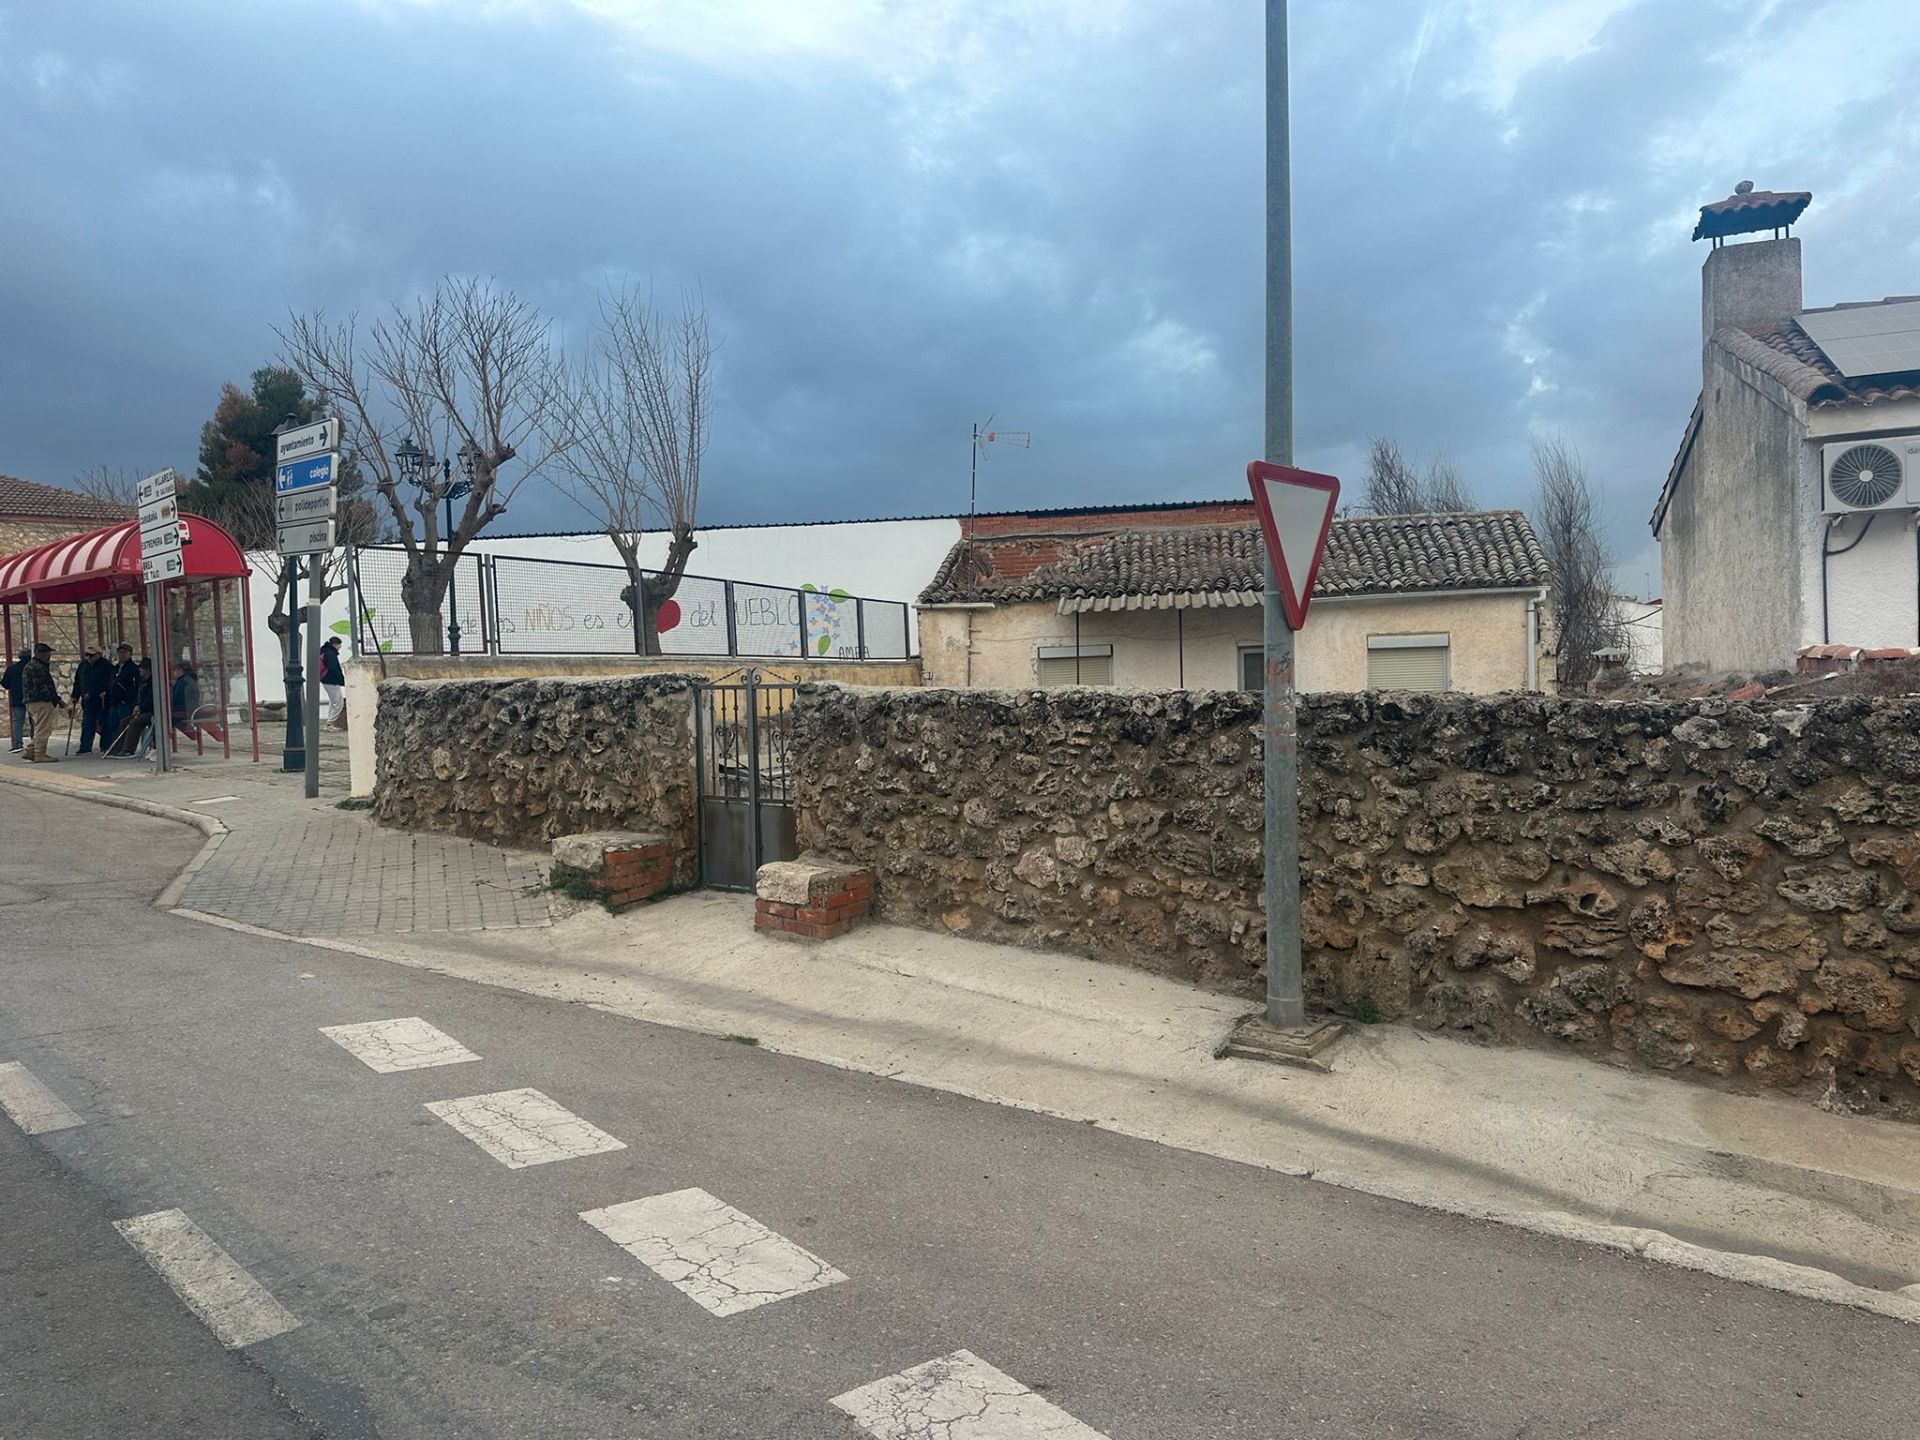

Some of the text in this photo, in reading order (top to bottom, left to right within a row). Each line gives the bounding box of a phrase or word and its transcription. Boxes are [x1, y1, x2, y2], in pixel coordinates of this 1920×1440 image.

[280, 435, 315, 455] ayuntamiento
[309, 465, 329, 480] colegio
[294, 497, 329, 512] polideportivo
[141, 537, 163, 551] ESTREMERA
[309, 530, 327, 545] piscina
[461, 611, 478, 635] de
[525, 603, 575, 631] NIÑOS
[583, 612, 604, 630] es
[690, 601, 717, 628] del
[735, 594, 800, 626] UEBLO
